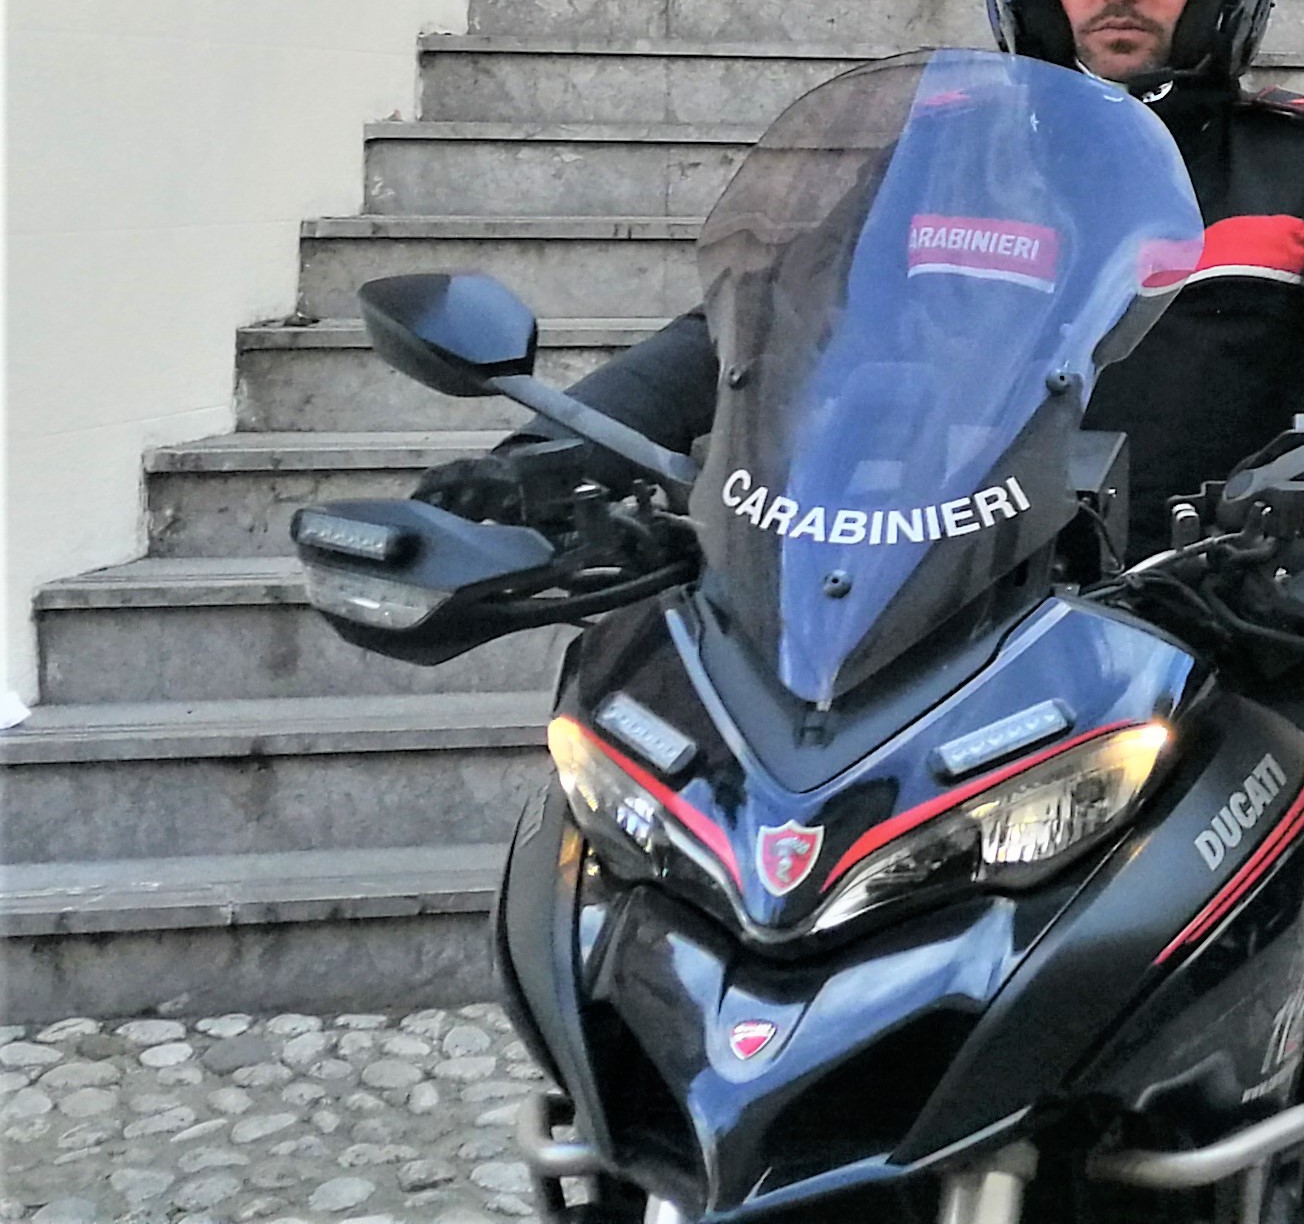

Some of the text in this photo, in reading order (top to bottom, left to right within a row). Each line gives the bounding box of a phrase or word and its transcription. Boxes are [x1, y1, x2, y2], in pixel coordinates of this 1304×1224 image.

[909, 226, 1040, 261] ARABINIERI
[722, 468, 1031, 546] CARABINIERI
[1193, 752, 1288, 872] DUCATI
